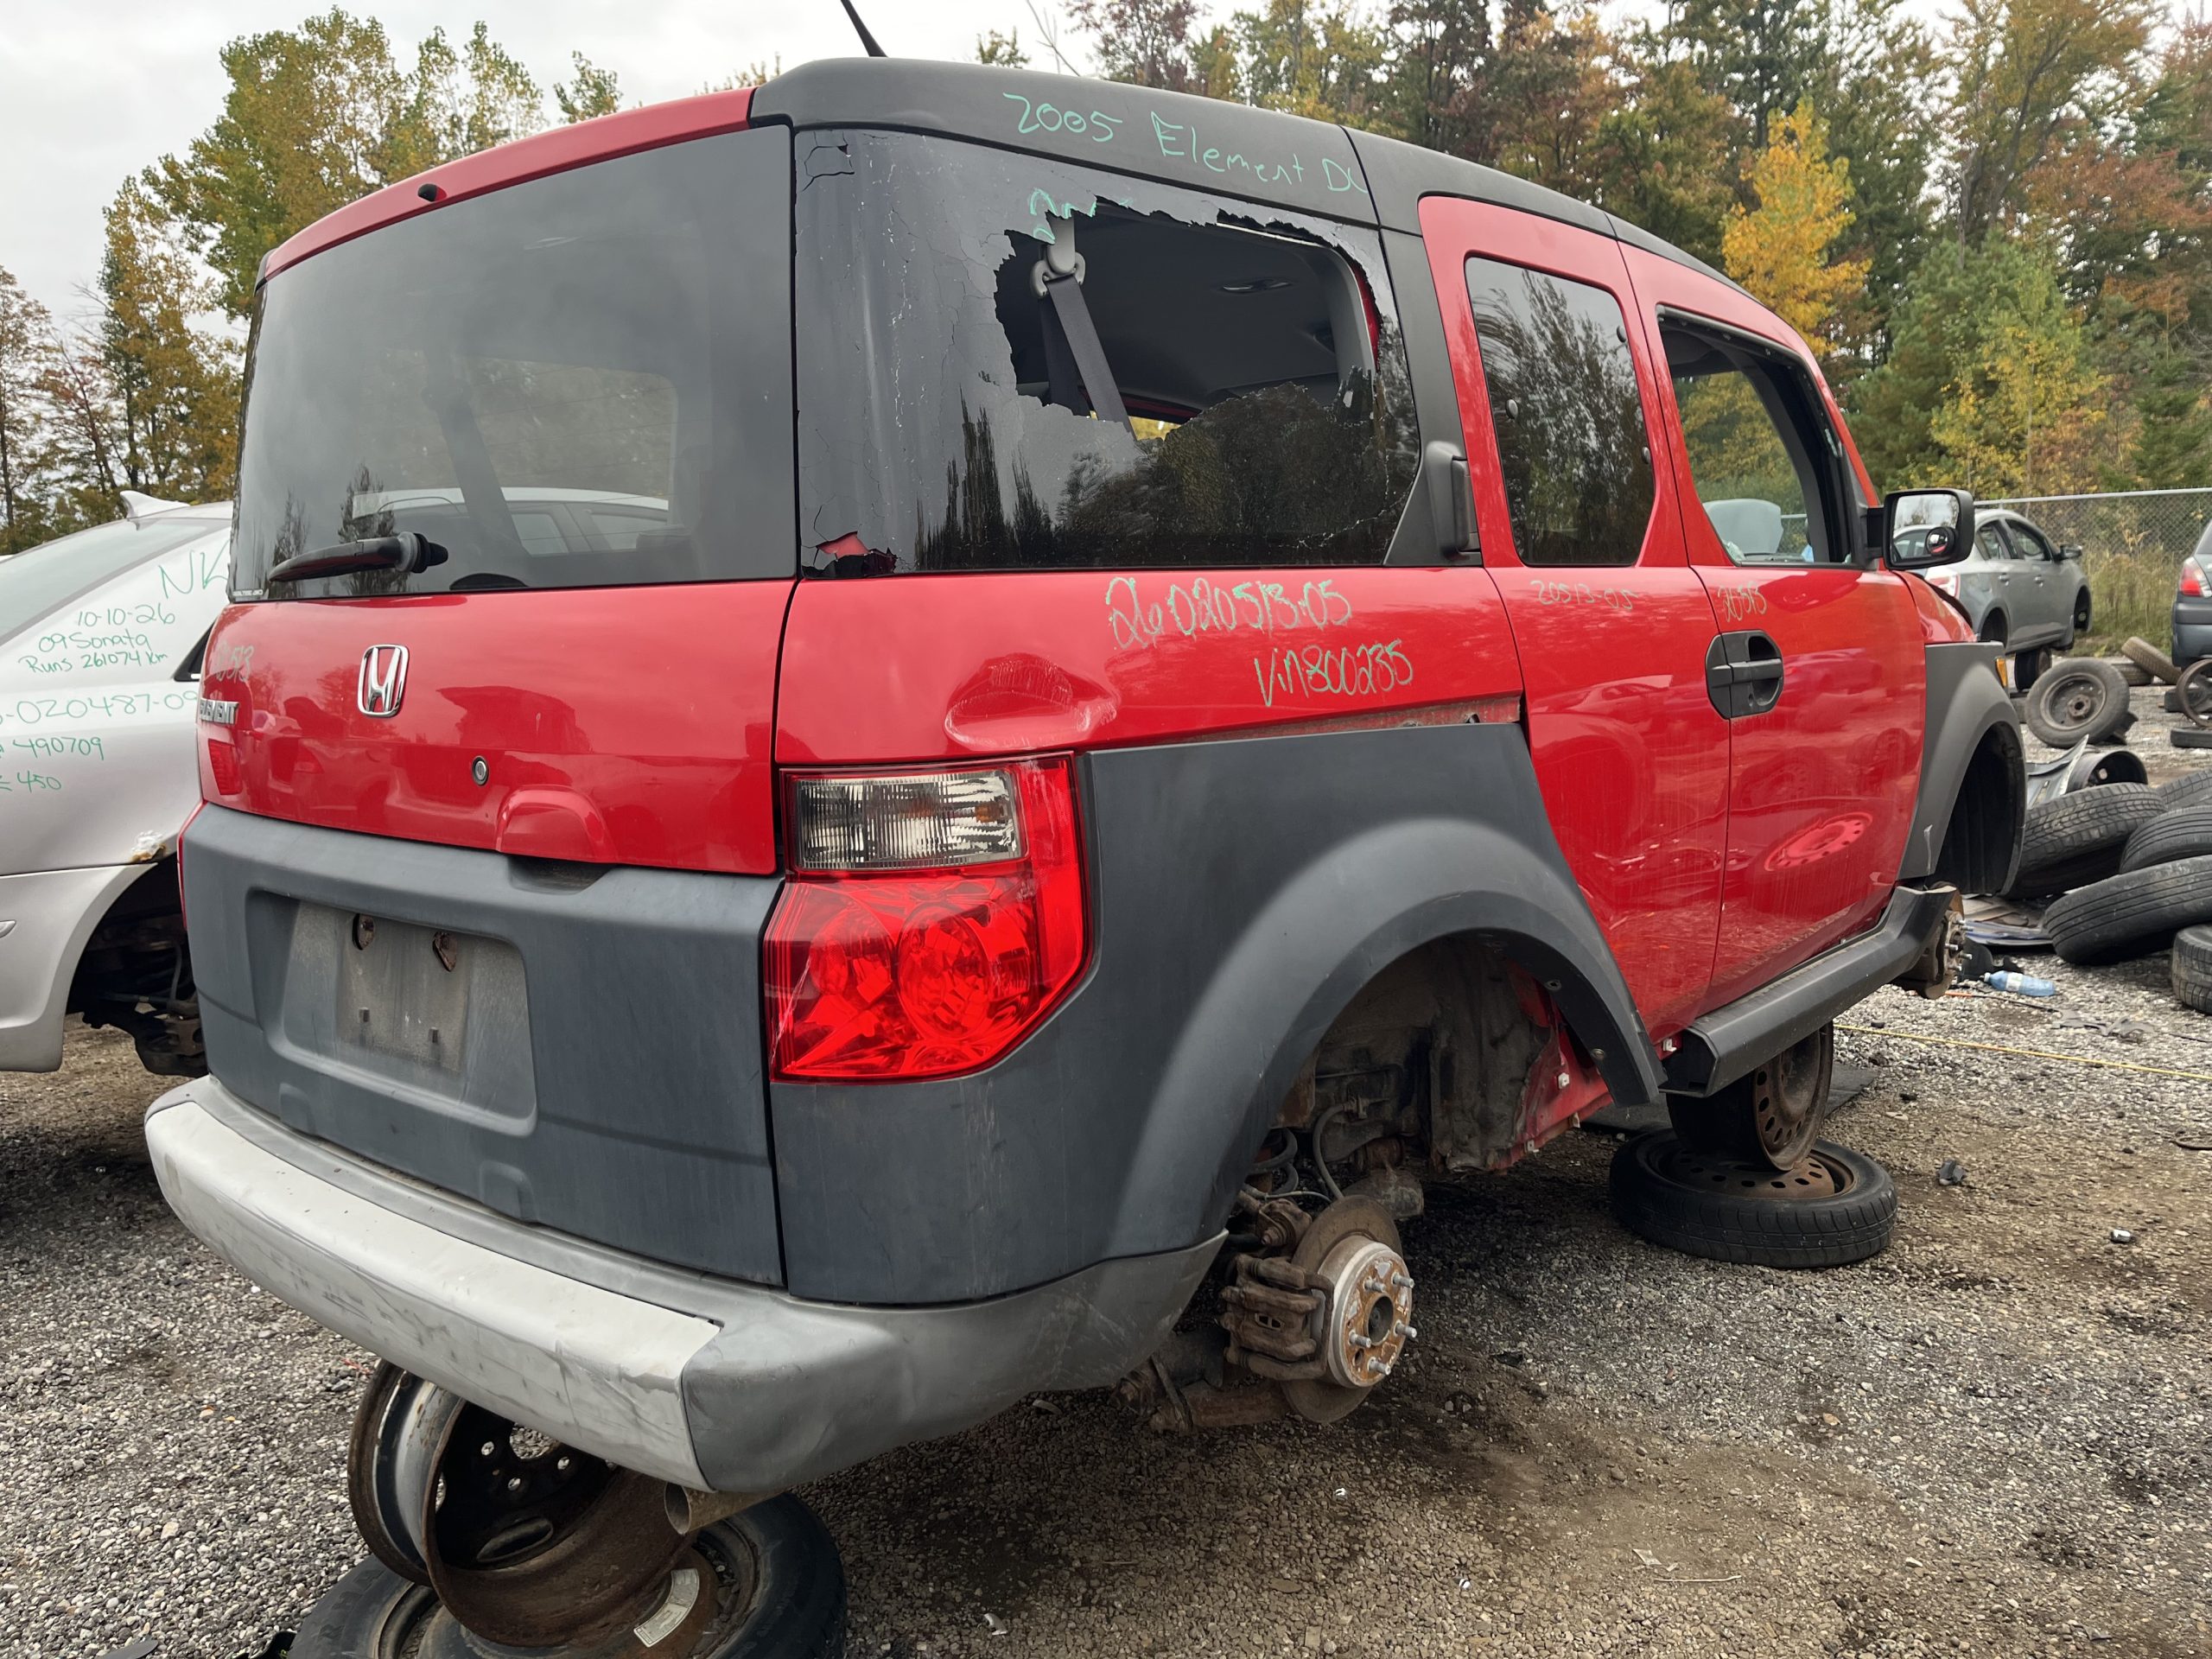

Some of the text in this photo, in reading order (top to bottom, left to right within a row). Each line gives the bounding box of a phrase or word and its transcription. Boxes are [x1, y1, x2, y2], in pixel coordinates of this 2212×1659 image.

[1002, 92, 1123, 143] 2005
[1150, 111, 1305, 185] Element
[77, 602, 176, 627] 10-10-26
[38, 628, 152, 653] 09 Sonata
[17, 655, 73, 674] Runs
[80, 650, 143, 670] 261074
[12, 736, 105, 761] 490709
[17, 770, 62, 793] 450
